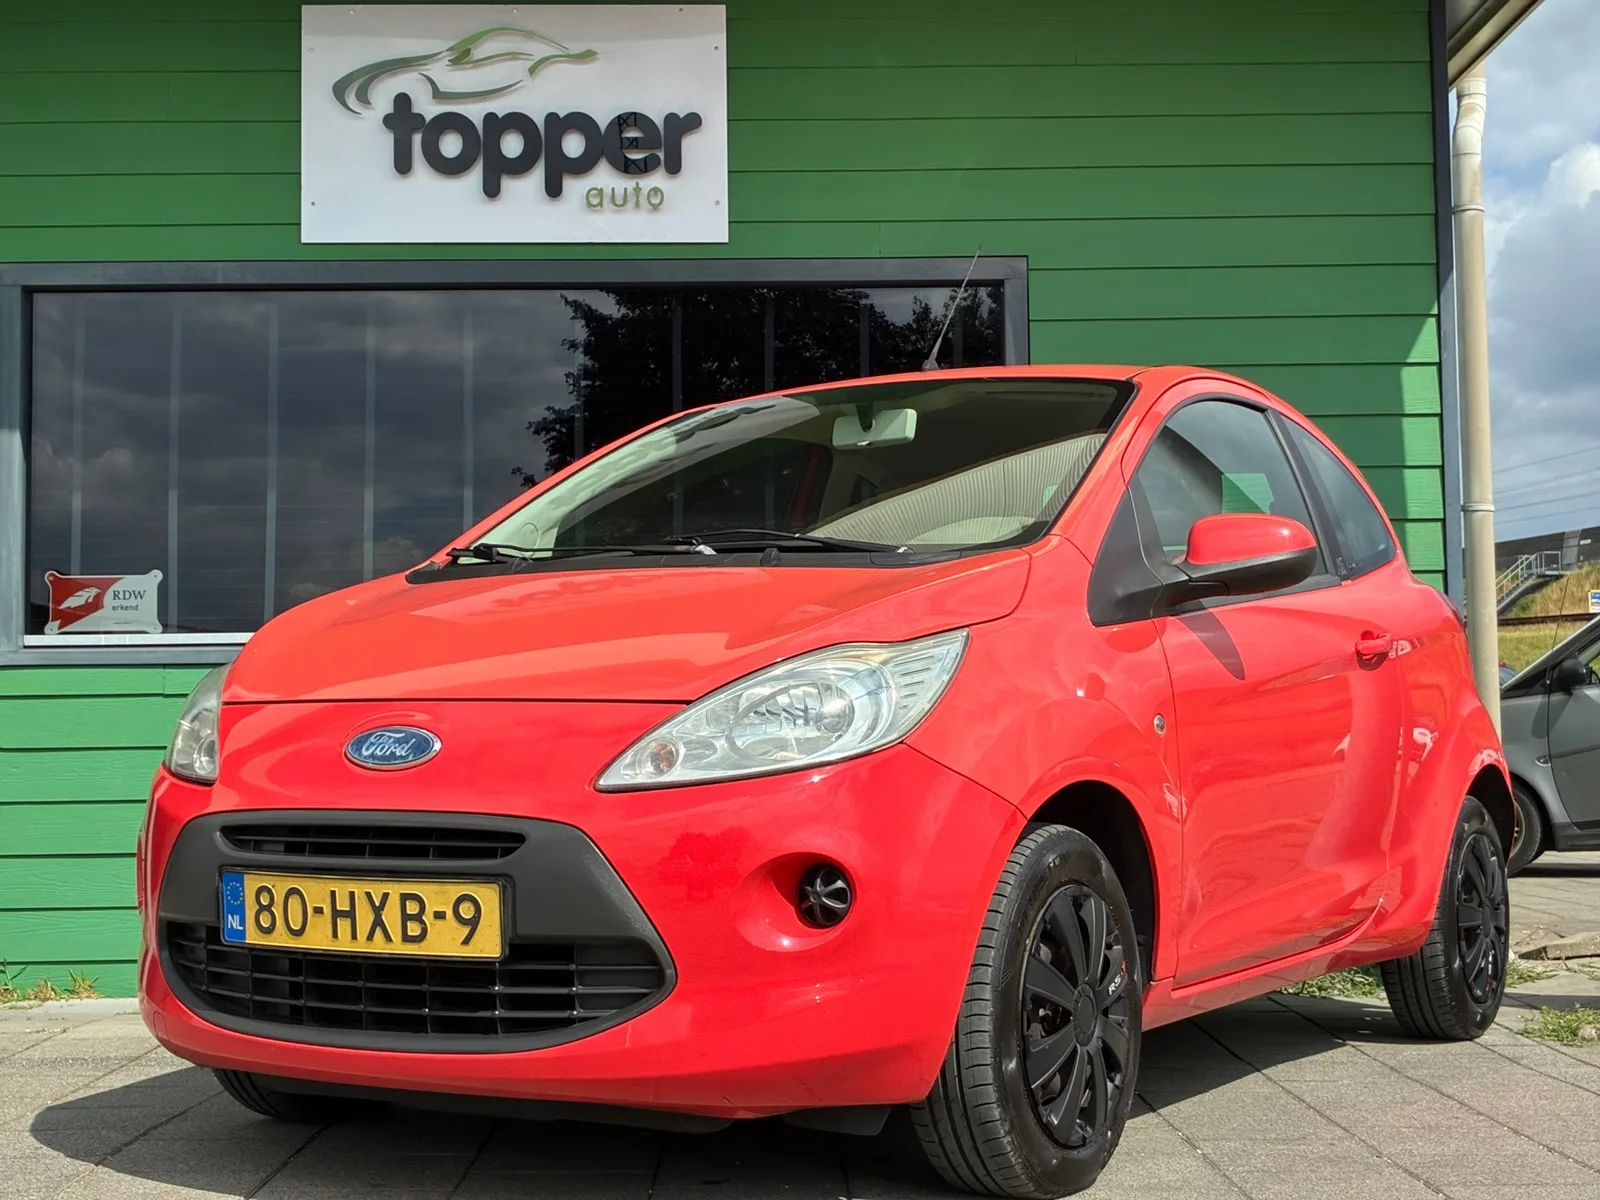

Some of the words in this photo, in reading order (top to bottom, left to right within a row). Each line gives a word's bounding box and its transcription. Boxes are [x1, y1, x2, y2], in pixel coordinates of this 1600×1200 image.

[382, 92, 702, 199] topper
[585, 182, 665, 210] auto
[112, 589, 146, 601] RDW
[361, 731, 416, 756] Ford
[227, 914, 244, 931] NL
[254, 884, 483, 946] 80-HXB-9
